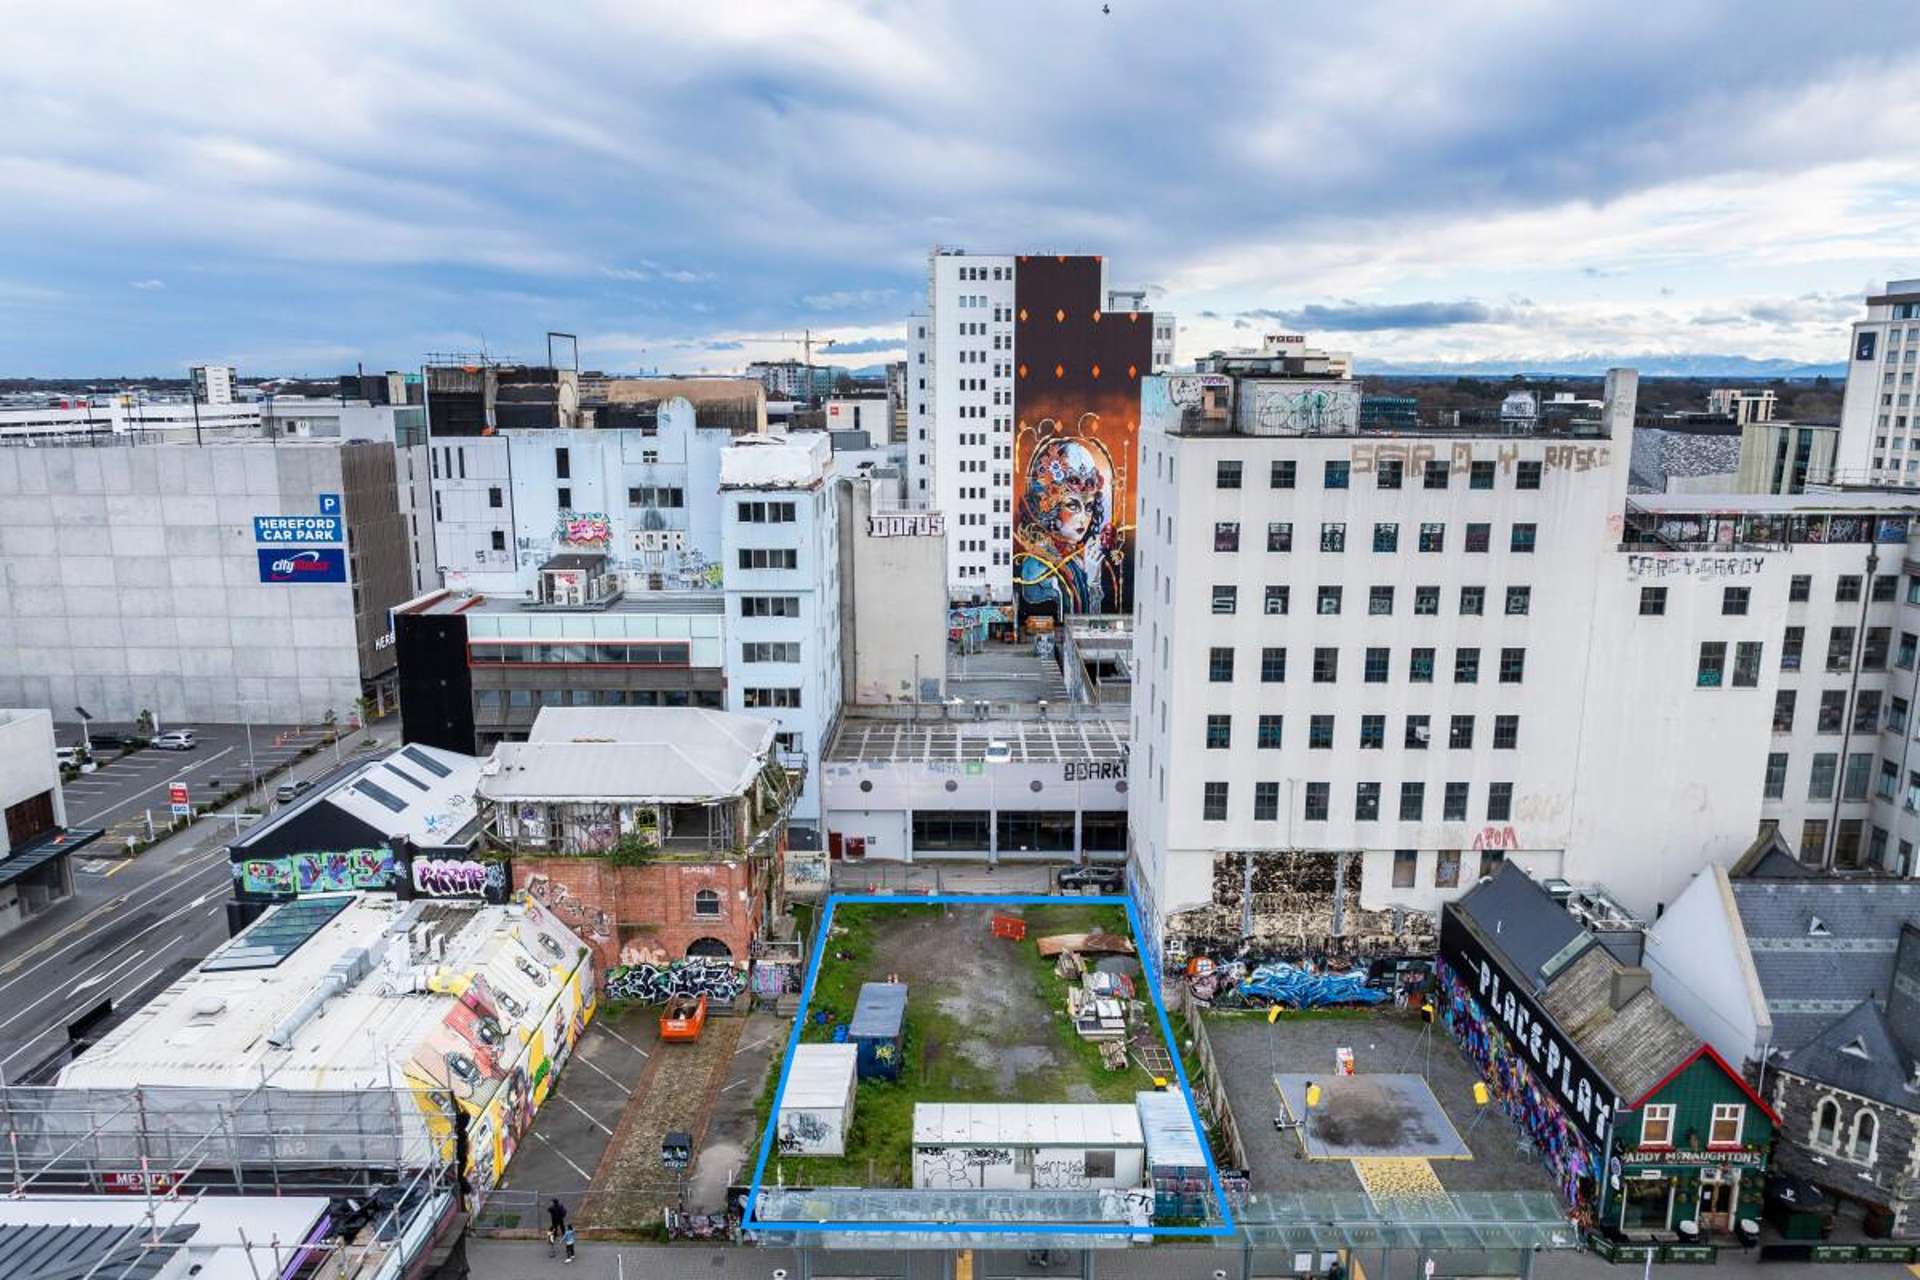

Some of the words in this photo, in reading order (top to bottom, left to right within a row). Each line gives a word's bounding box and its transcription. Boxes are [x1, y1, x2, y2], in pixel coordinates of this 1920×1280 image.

[324, 498, 336, 512] P
[259, 519, 336, 529] HEREFORD
[263, 530, 293, 541] CAR
[296, 530, 335, 541] PARK
